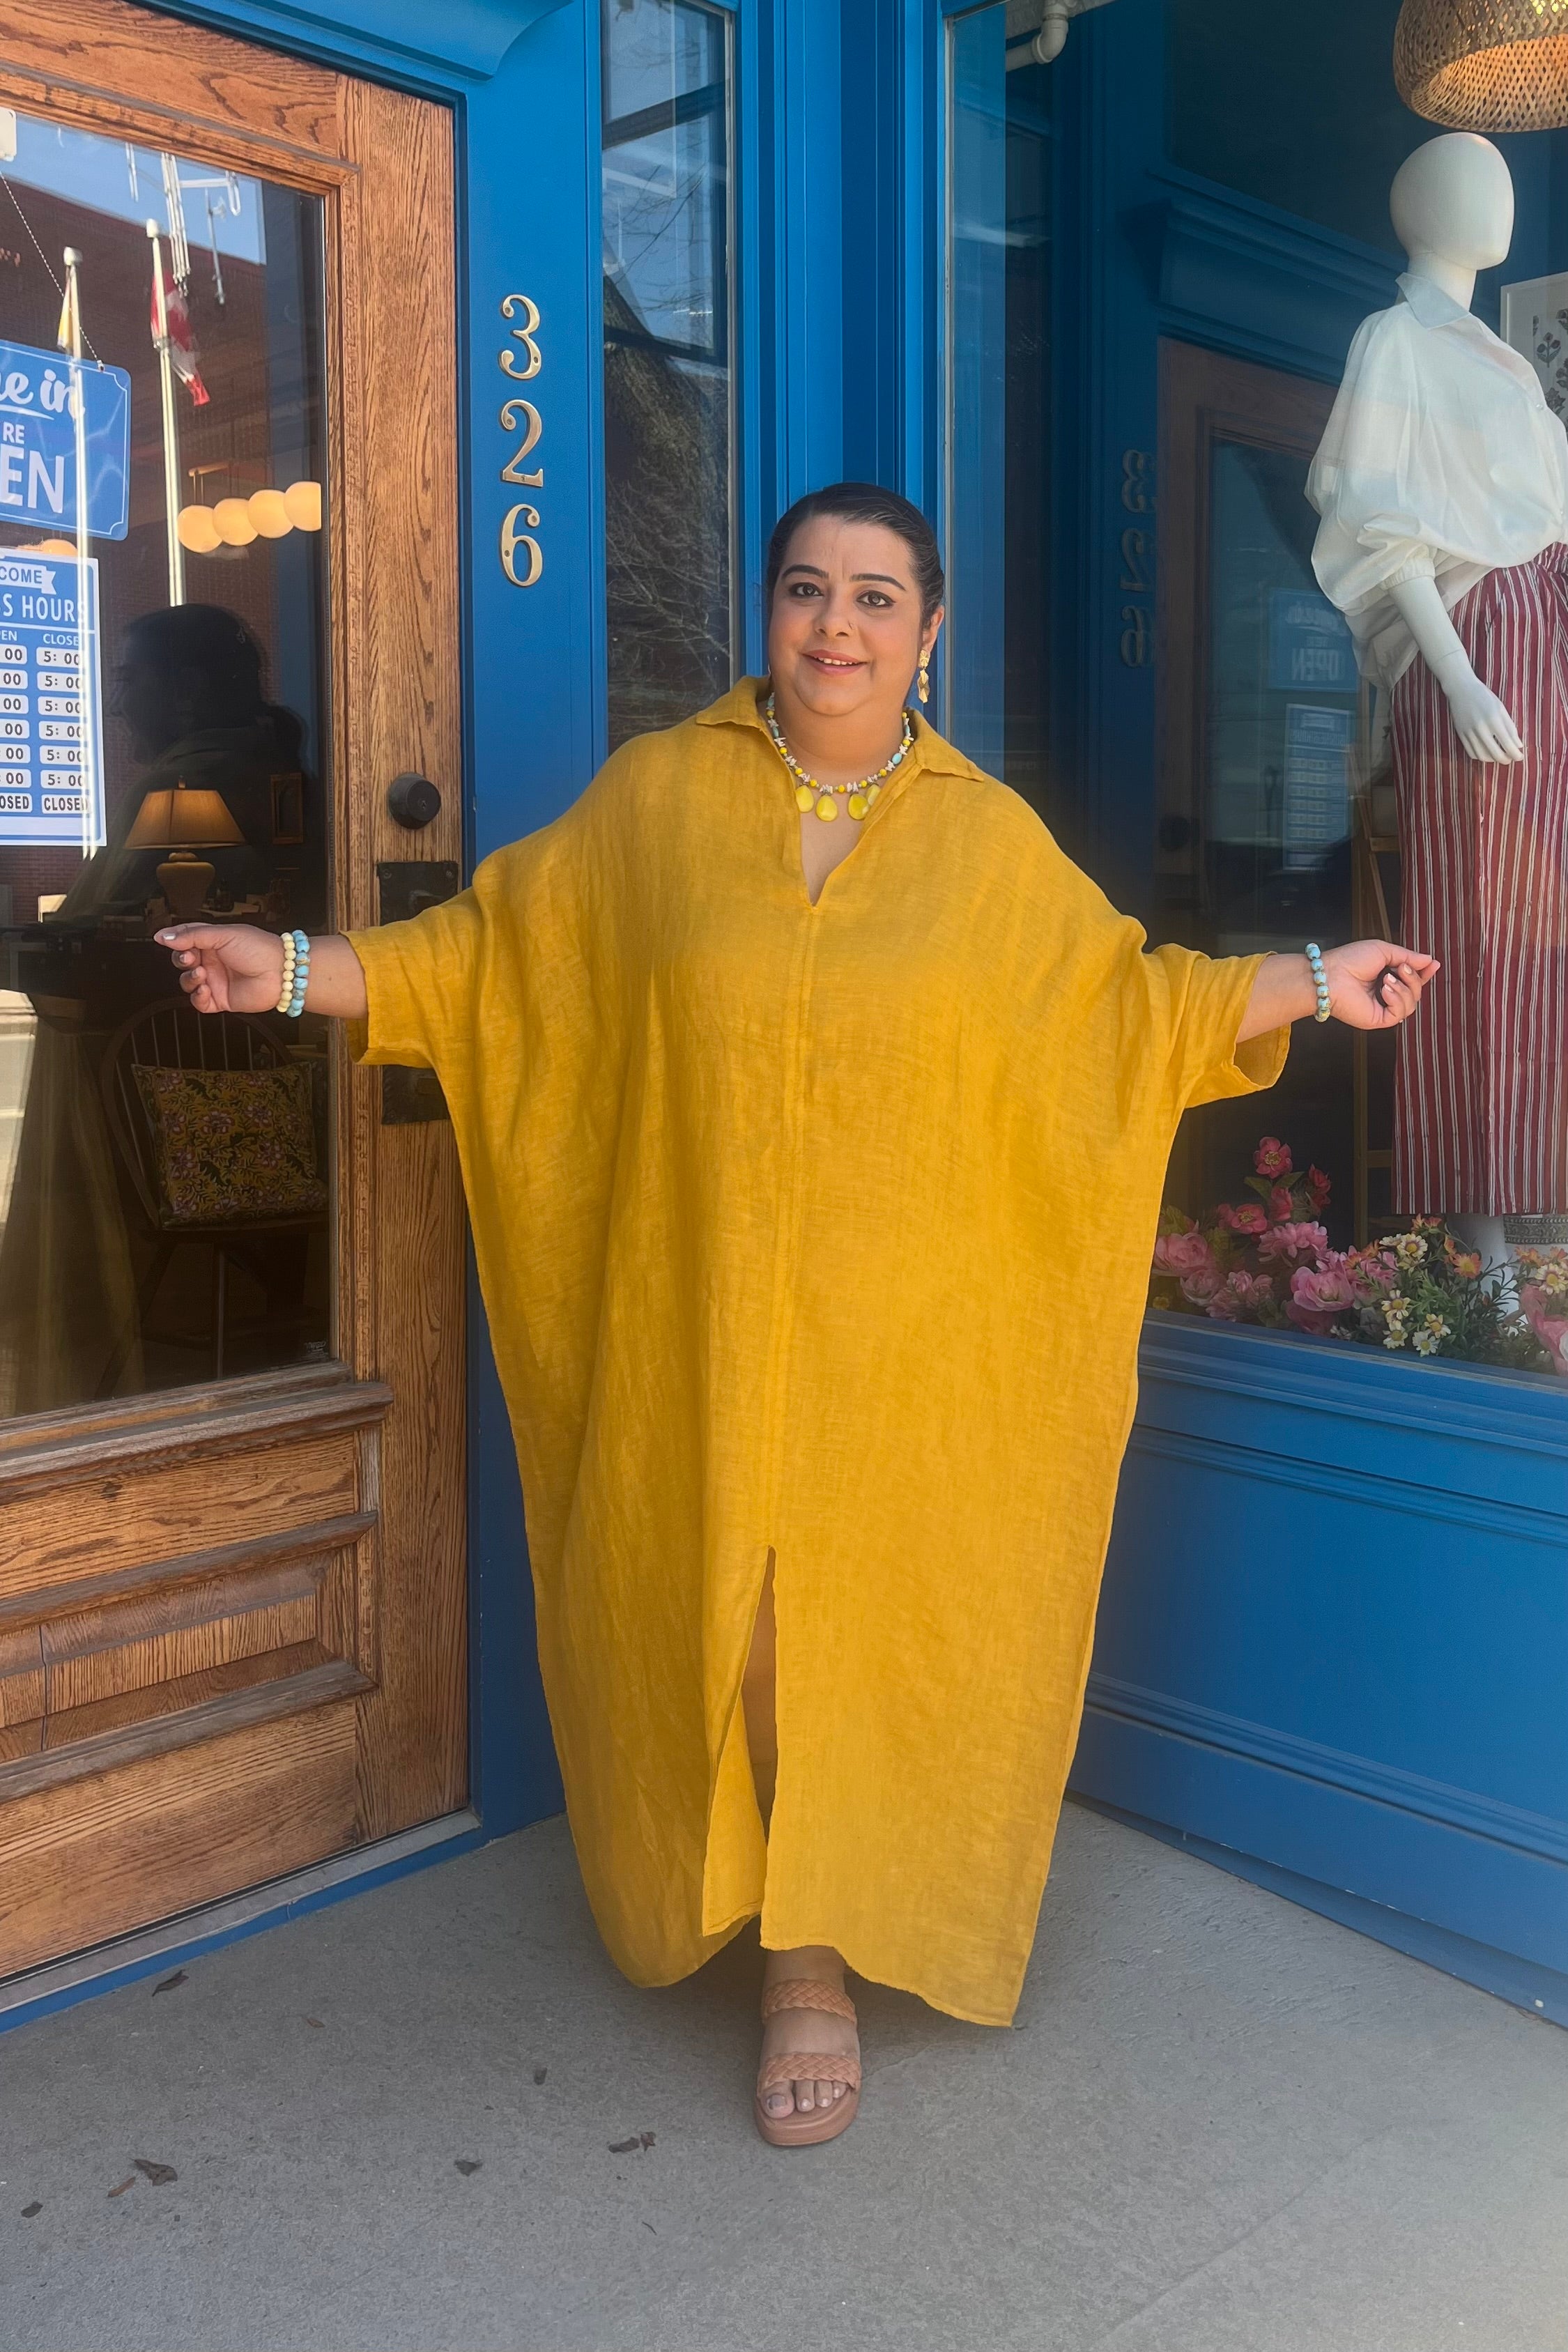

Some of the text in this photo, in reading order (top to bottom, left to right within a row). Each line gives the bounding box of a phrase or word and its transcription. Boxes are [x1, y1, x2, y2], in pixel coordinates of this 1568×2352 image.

[0, 372, 34, 404] e
[498, 293, 544, 587] 326
[0, 443, 65, 514] EN
[0, 593, 13, 617] S
[0, 629, 17, 641] EN
